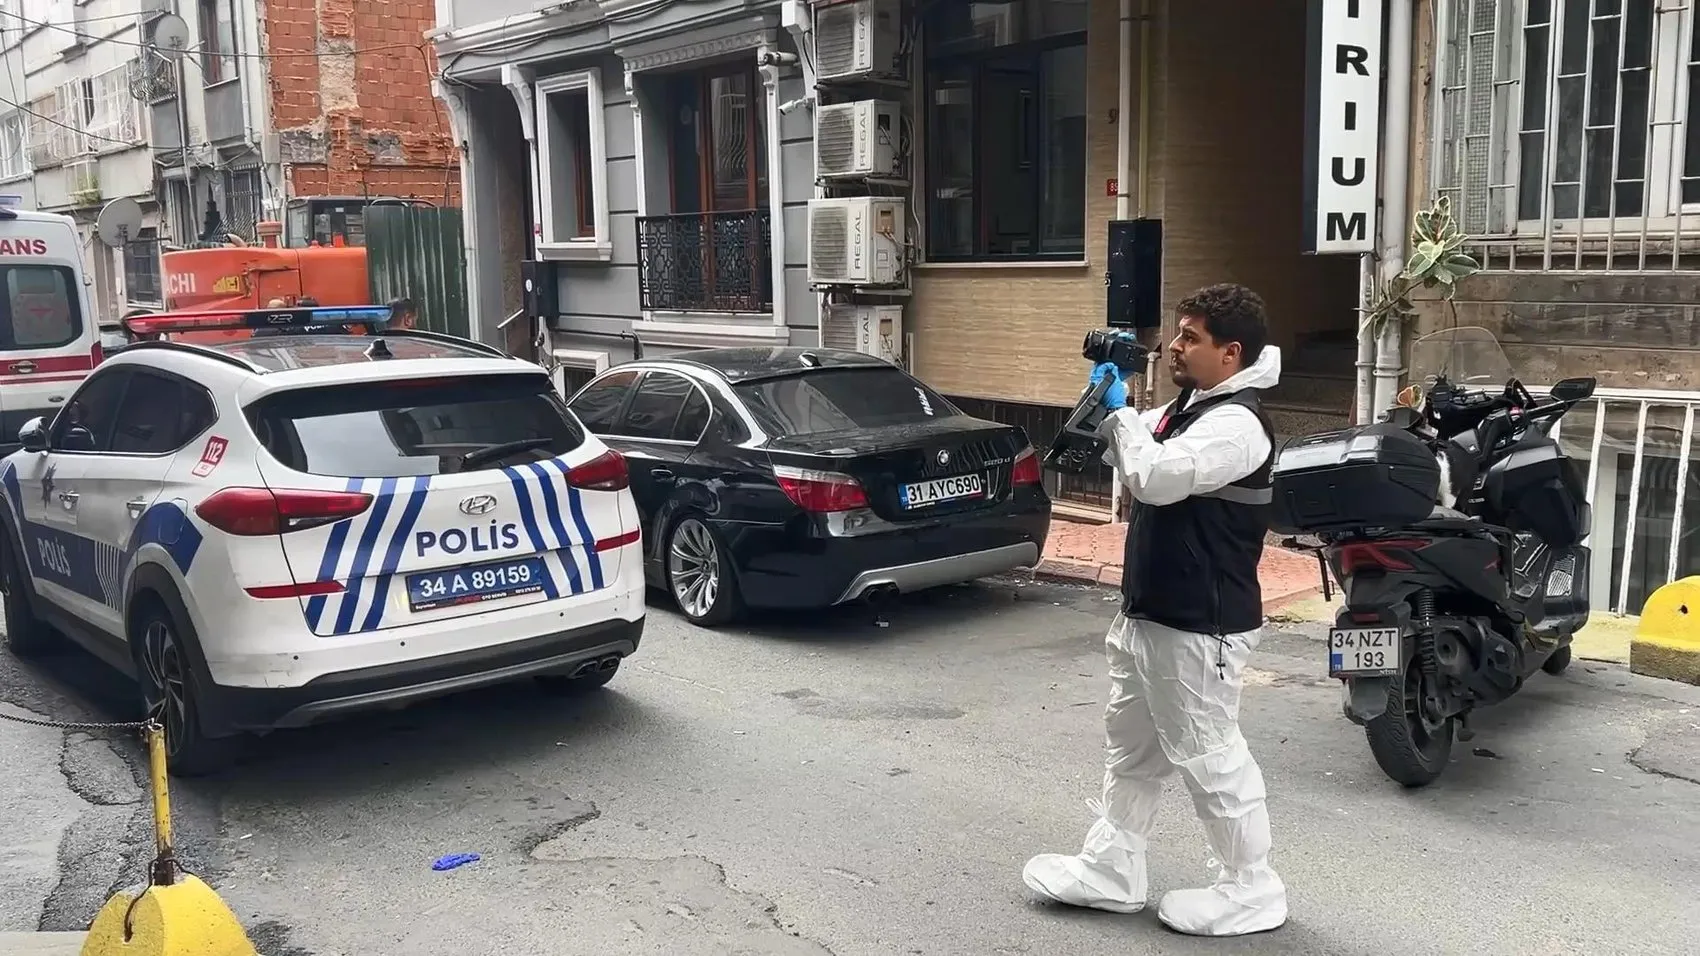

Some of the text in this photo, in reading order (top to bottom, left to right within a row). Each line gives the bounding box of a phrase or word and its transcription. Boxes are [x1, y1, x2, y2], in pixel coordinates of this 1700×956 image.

[0, 239, 47, 255] ANS
[205, 441, 224, 463] 112
[908, 474, 980, 502] 31 AYC690
[416, 519, 519, 557] POLİS
[37, 537, 72, 577] POLİS
[420, 565, 531, 597] 34 A 89159
[1334, 630, 1396, 648] 34 NZT
[1354, 651, 1385, 668] 193
